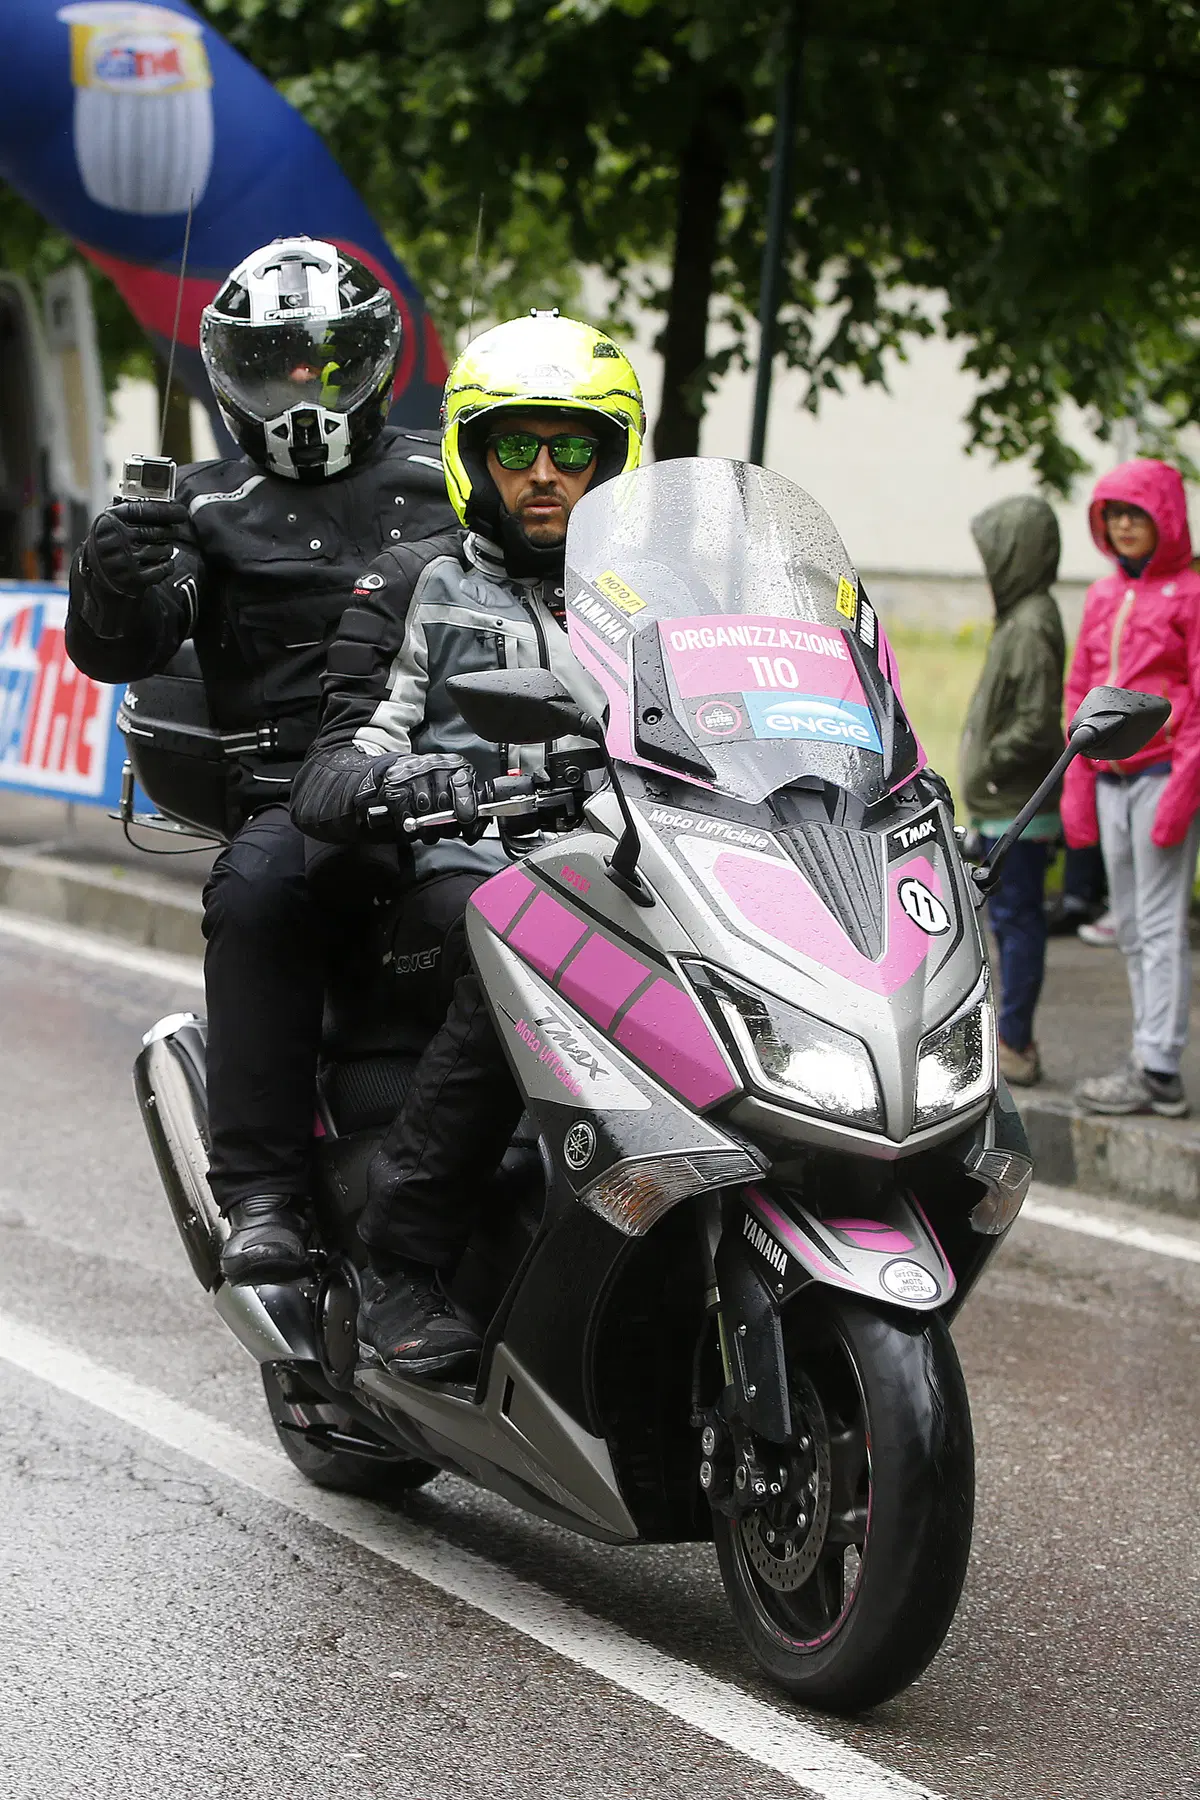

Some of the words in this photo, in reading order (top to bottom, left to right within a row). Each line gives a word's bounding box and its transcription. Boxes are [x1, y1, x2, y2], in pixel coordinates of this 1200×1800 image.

[265, 306, 326, 320] CABERG
[570, 589, 628, 643] YAMAHA
[669, 626, 848, 661] ORGANIZZAZIONE
[747, 656, 800, 689] 110
[648, 809, 694, 829] Moto
[695, 819, 769, 849] Ufficiale
[908, 889, 936, 923] 11
[513, 1018, 541, 1053] Moto
[539, 1045, 584, 1097] Ufficiale
[741, 1213, 789, 1277] YAMAHA
